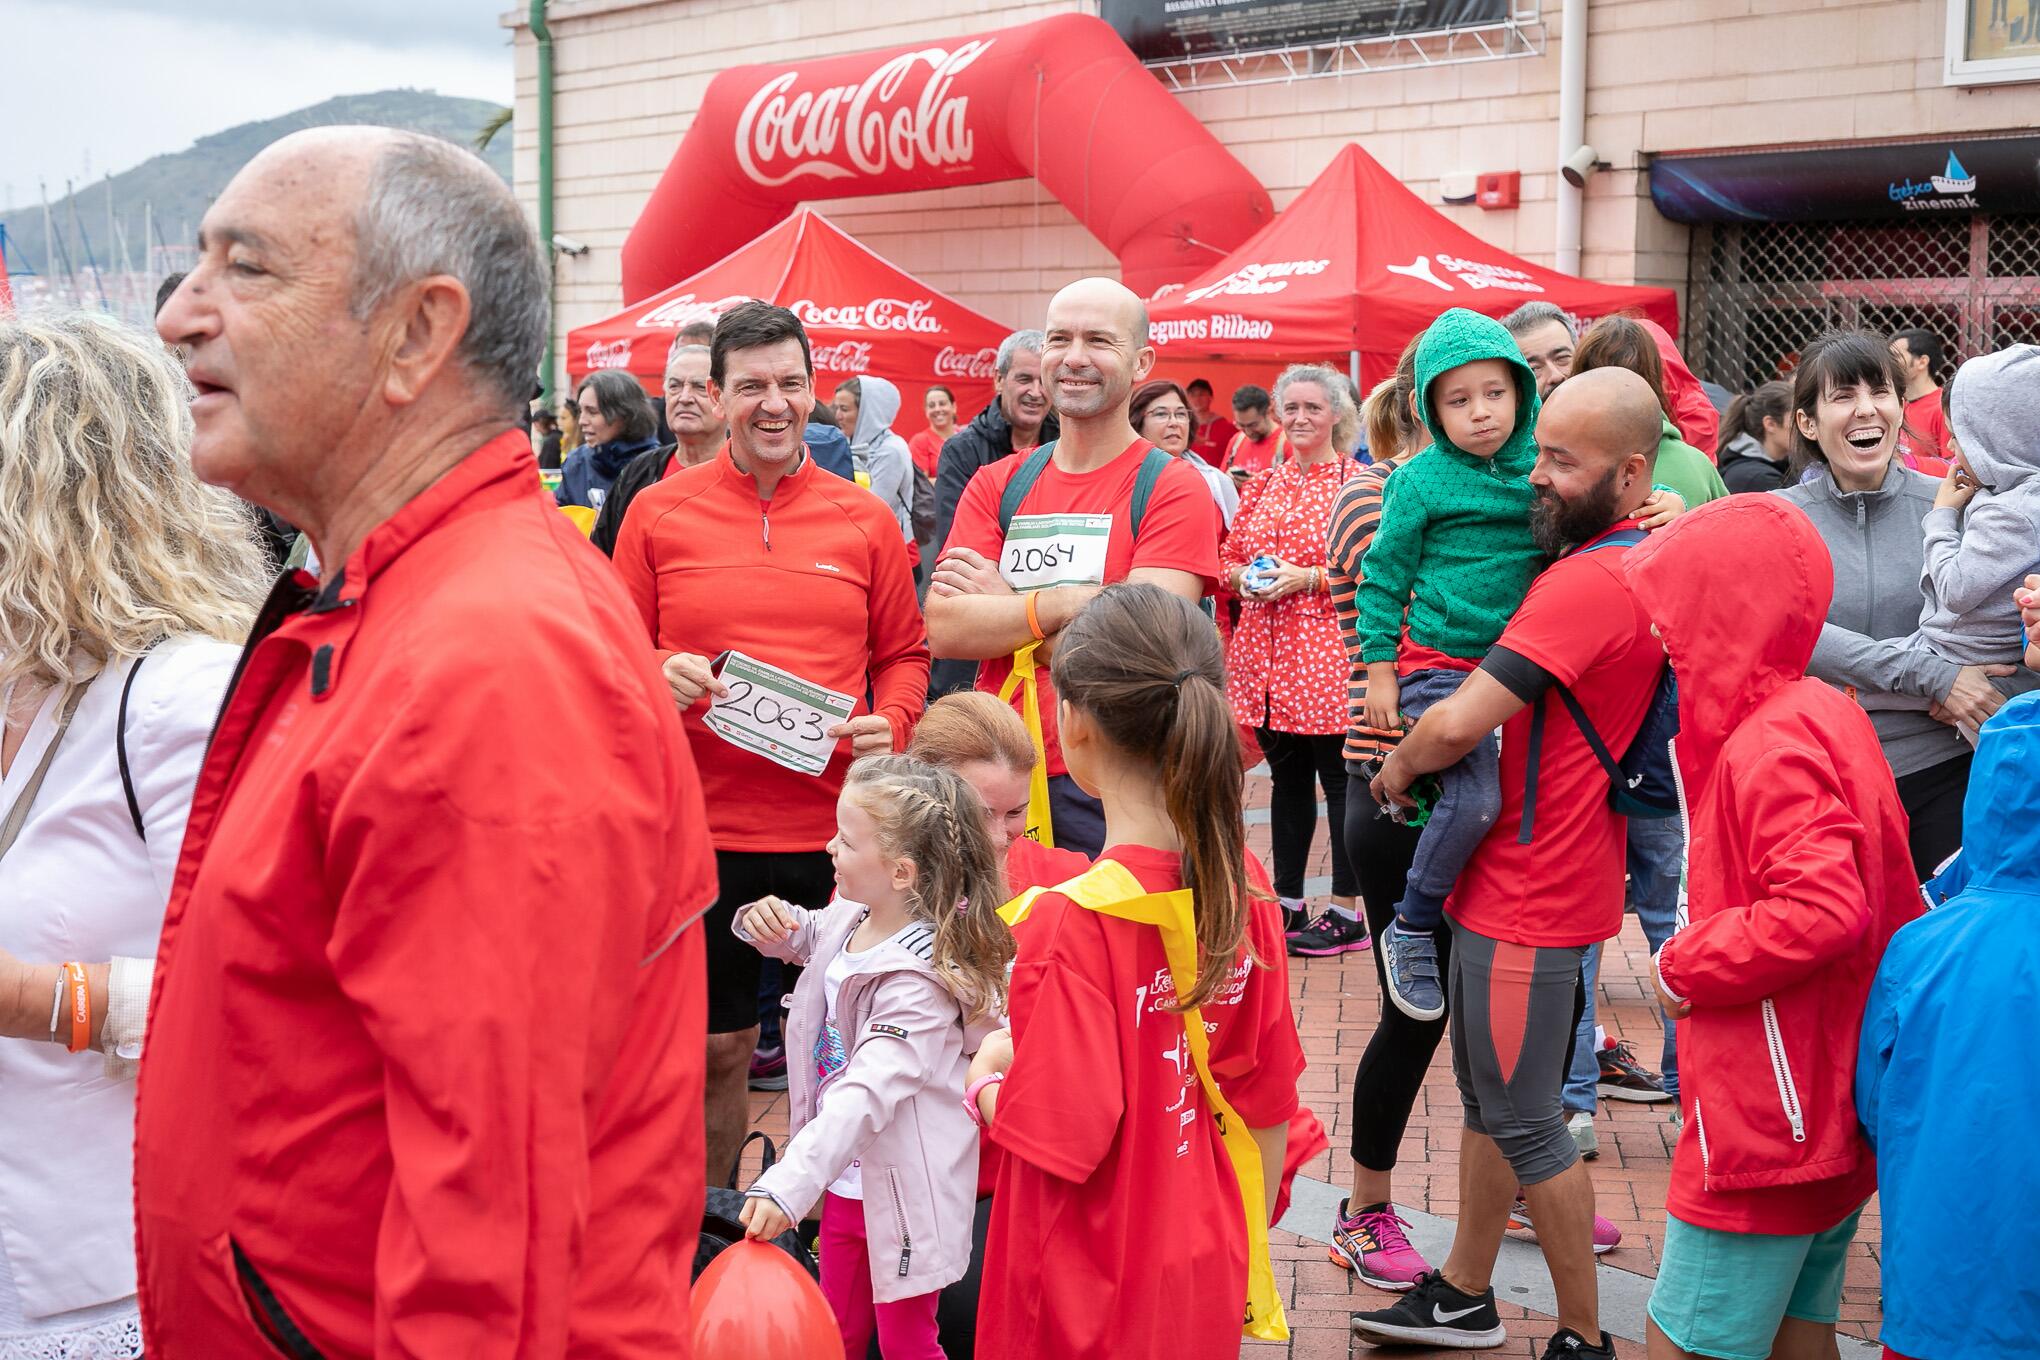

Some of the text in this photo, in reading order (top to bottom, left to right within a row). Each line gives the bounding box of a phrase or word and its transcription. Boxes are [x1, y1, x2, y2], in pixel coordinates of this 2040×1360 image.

[735, 37, 997, 186] Coca-Cola
[1902, 194, 1980, 211] zinemak
[789, 298, 942, 333] Coca-Cola
[1147, 314, 1273, 345] eguros Bilbao
[1010, 542, 1075, 573] 2064
[714, 681, 824, 742] 2063
